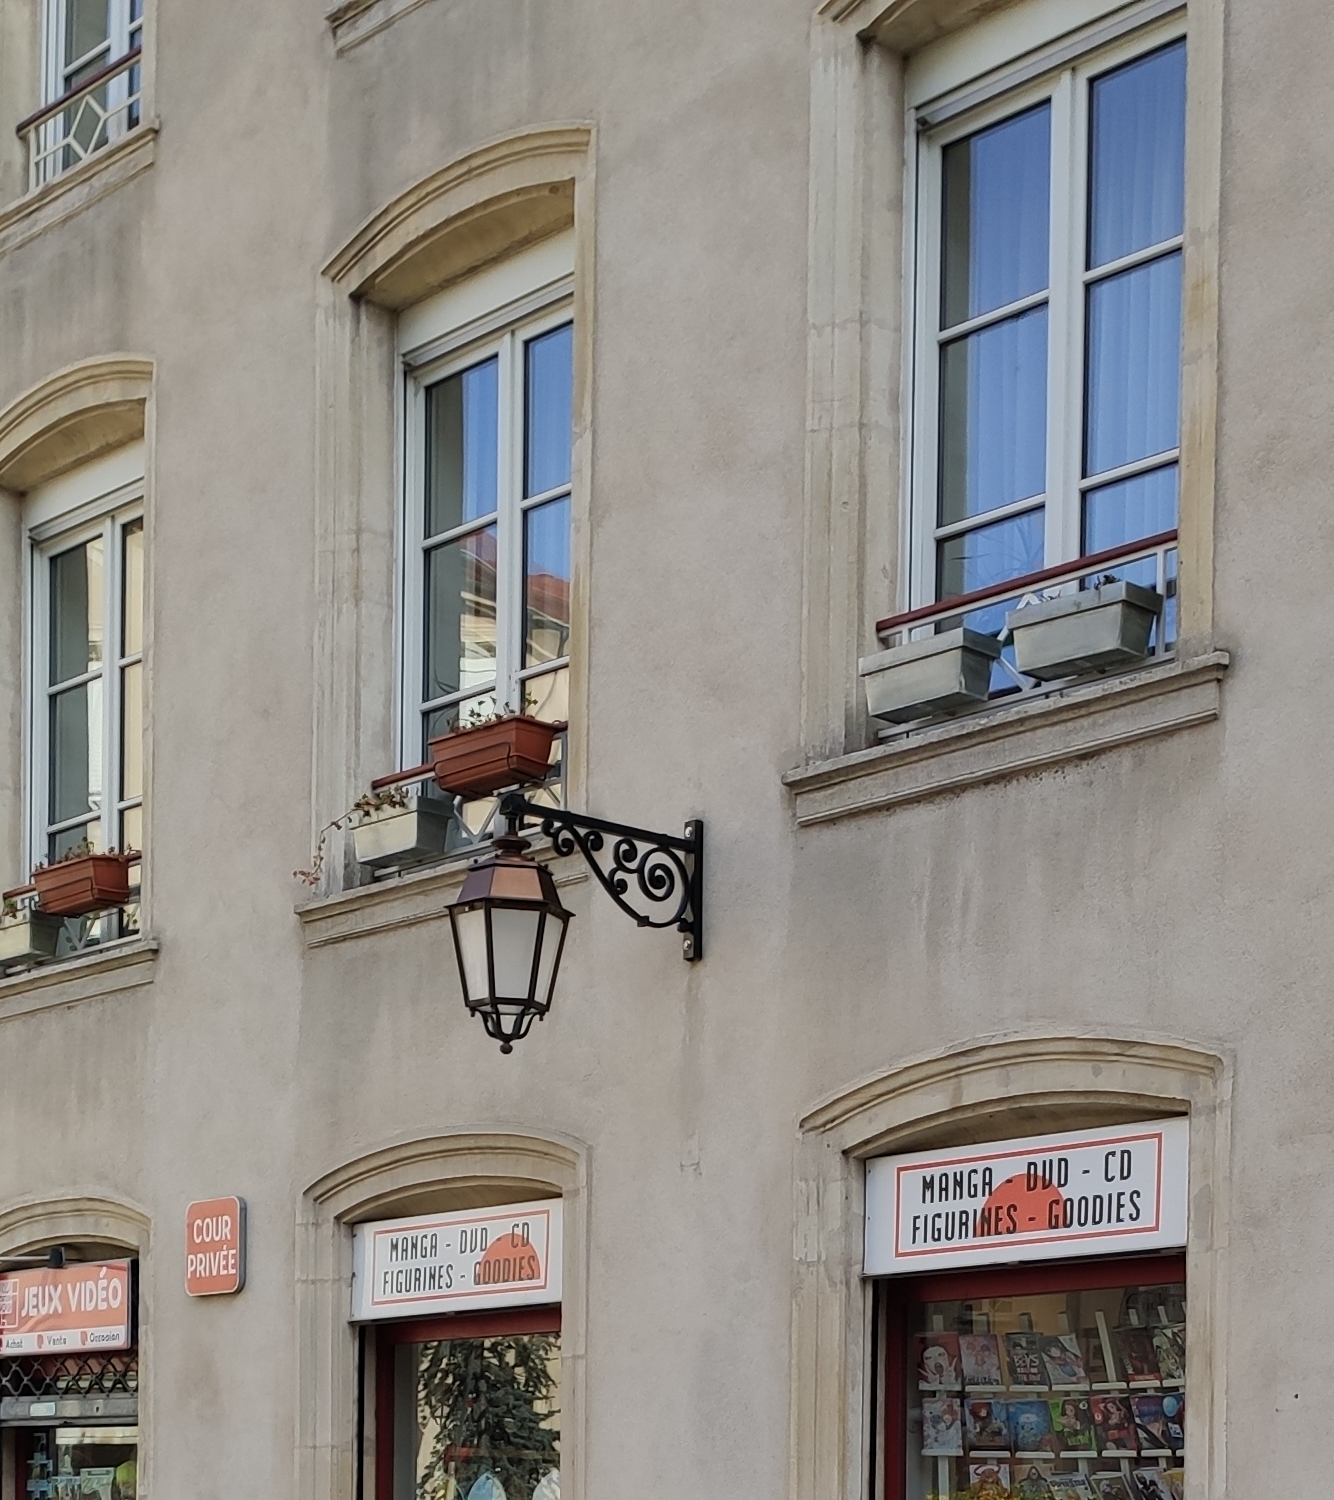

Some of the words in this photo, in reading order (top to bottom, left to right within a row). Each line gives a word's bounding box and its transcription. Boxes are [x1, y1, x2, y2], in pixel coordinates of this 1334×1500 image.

[921, 1166, 993, 1205] MANGA
[1026, 1156, 1069, 1192] DVD
[1104, 1149, 1133, 1183] CD
[192, 1214, 232, 1244] COUR
[911, 1203, 1018, 1245] FIGURINES
[1047, 1189, 1142, 1230] GOODIES
[186, 1244, 237, 1280] PRIVÉE
[389, 1232, 438, 1263] MANGA
[459, 1226, 489, 1254] DVD
[510, 1221, 530, 1248] CD
[20, 1283, 62, 1317] JEUX
[66, 1266, 122, 1313] VIDÉO
[382, 1263, 454, 1296] FIGURINES
[473, 1254, 536, 1286] GOODIES
[5, 1339, 24, 1349] Achat
[46, 1335, 67, 1346] Vente
